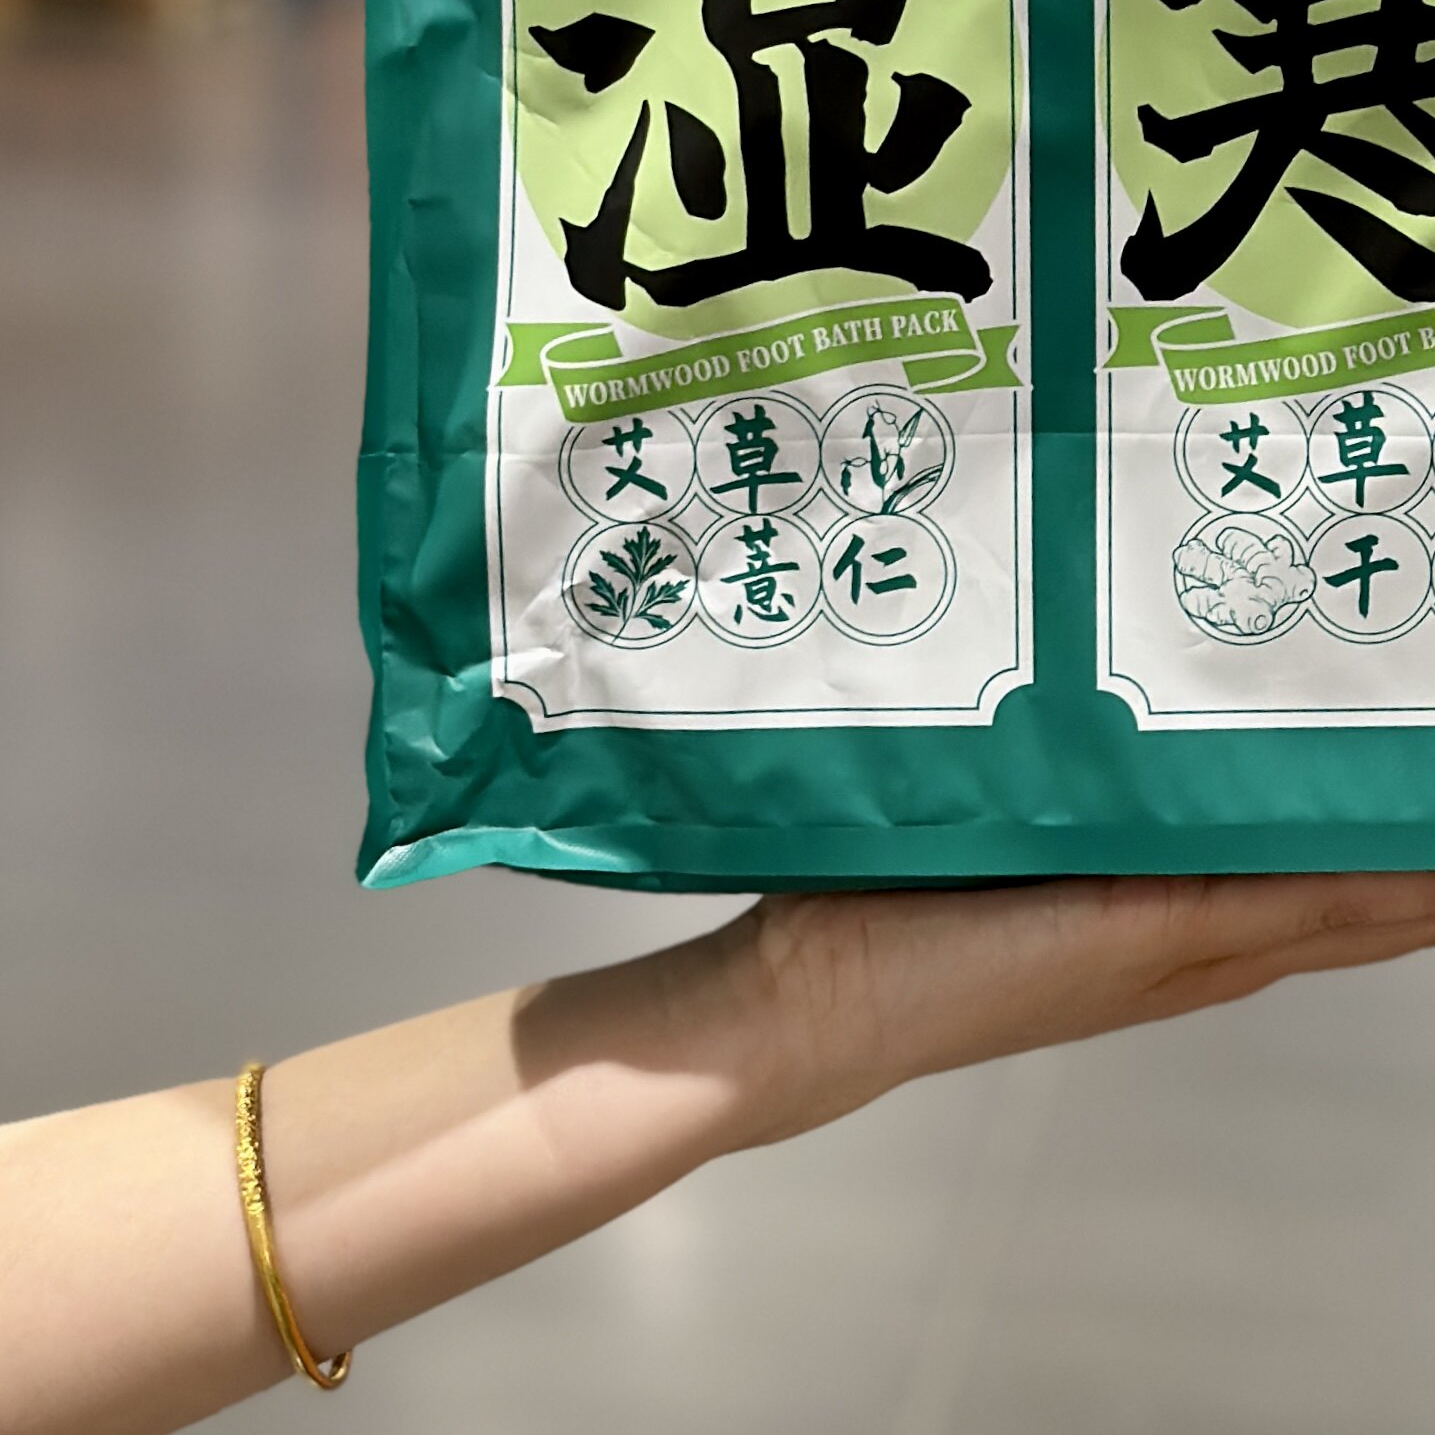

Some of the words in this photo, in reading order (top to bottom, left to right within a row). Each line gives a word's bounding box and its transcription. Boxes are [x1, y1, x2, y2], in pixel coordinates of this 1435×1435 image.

[564, 353, 731, 409] WORMWOOD
[738, 335, 805, 375] FOOT
[813, 320, 883, 353] BATH
[892, 308, 960, 340] PACK
[1173, 349, 1337, 395] WORMWOOD
[1344, 331, 1411, 368] FOOT
[602, 403, 803, 515] 艾草
[1218, 389, 1411, 509] 艾草
[719, 518, 918, 626] 薏仁
